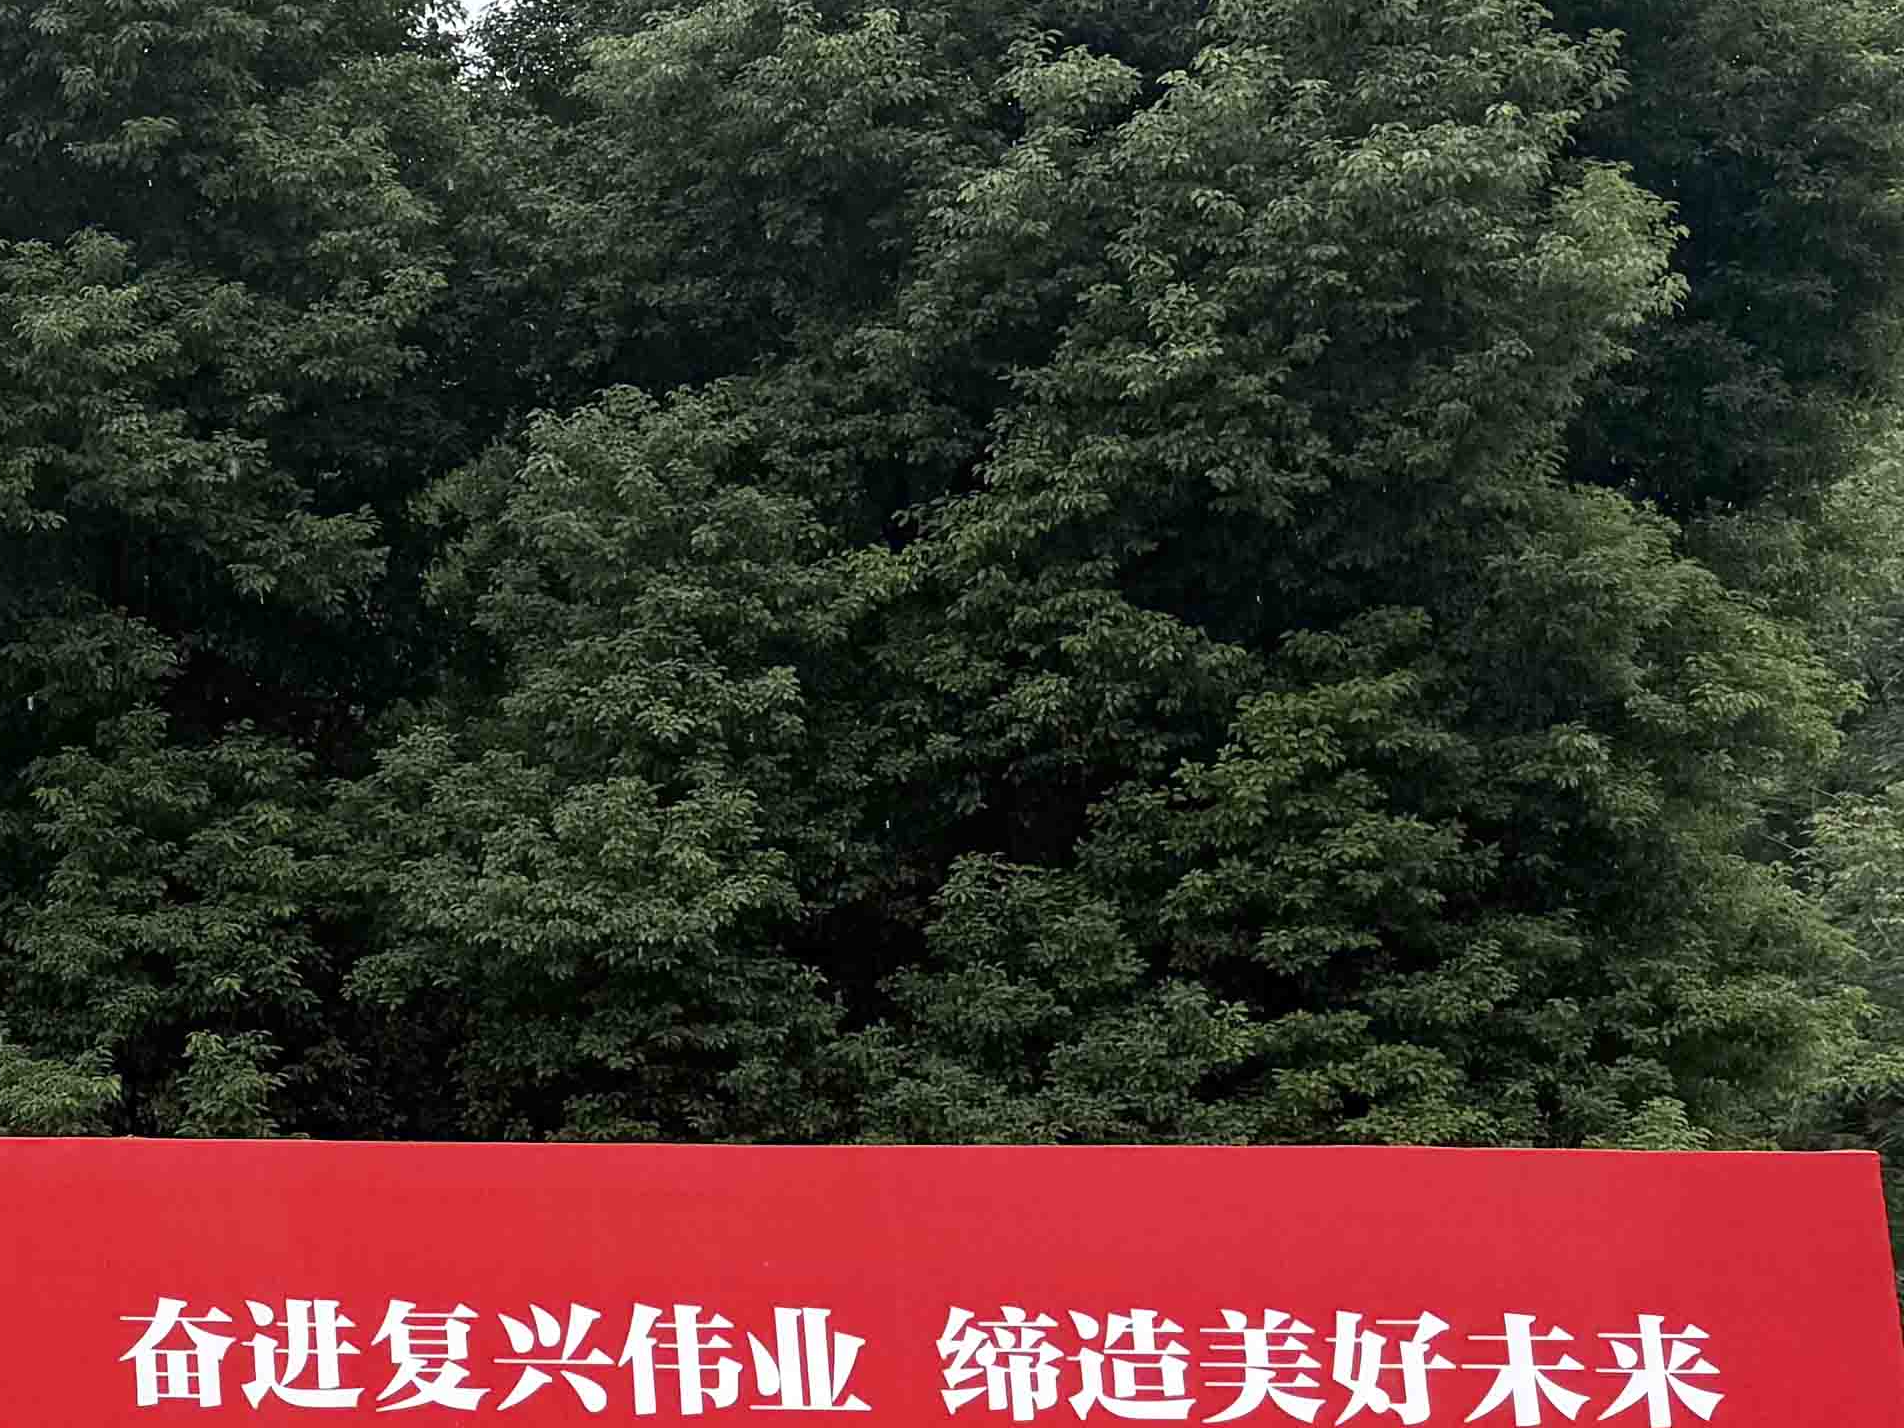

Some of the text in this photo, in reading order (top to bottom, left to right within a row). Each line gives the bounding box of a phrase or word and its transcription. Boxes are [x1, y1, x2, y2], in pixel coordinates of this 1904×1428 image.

[118, 1296, 1726, 1428] 奋进复兴伟业 缔造美好未来
